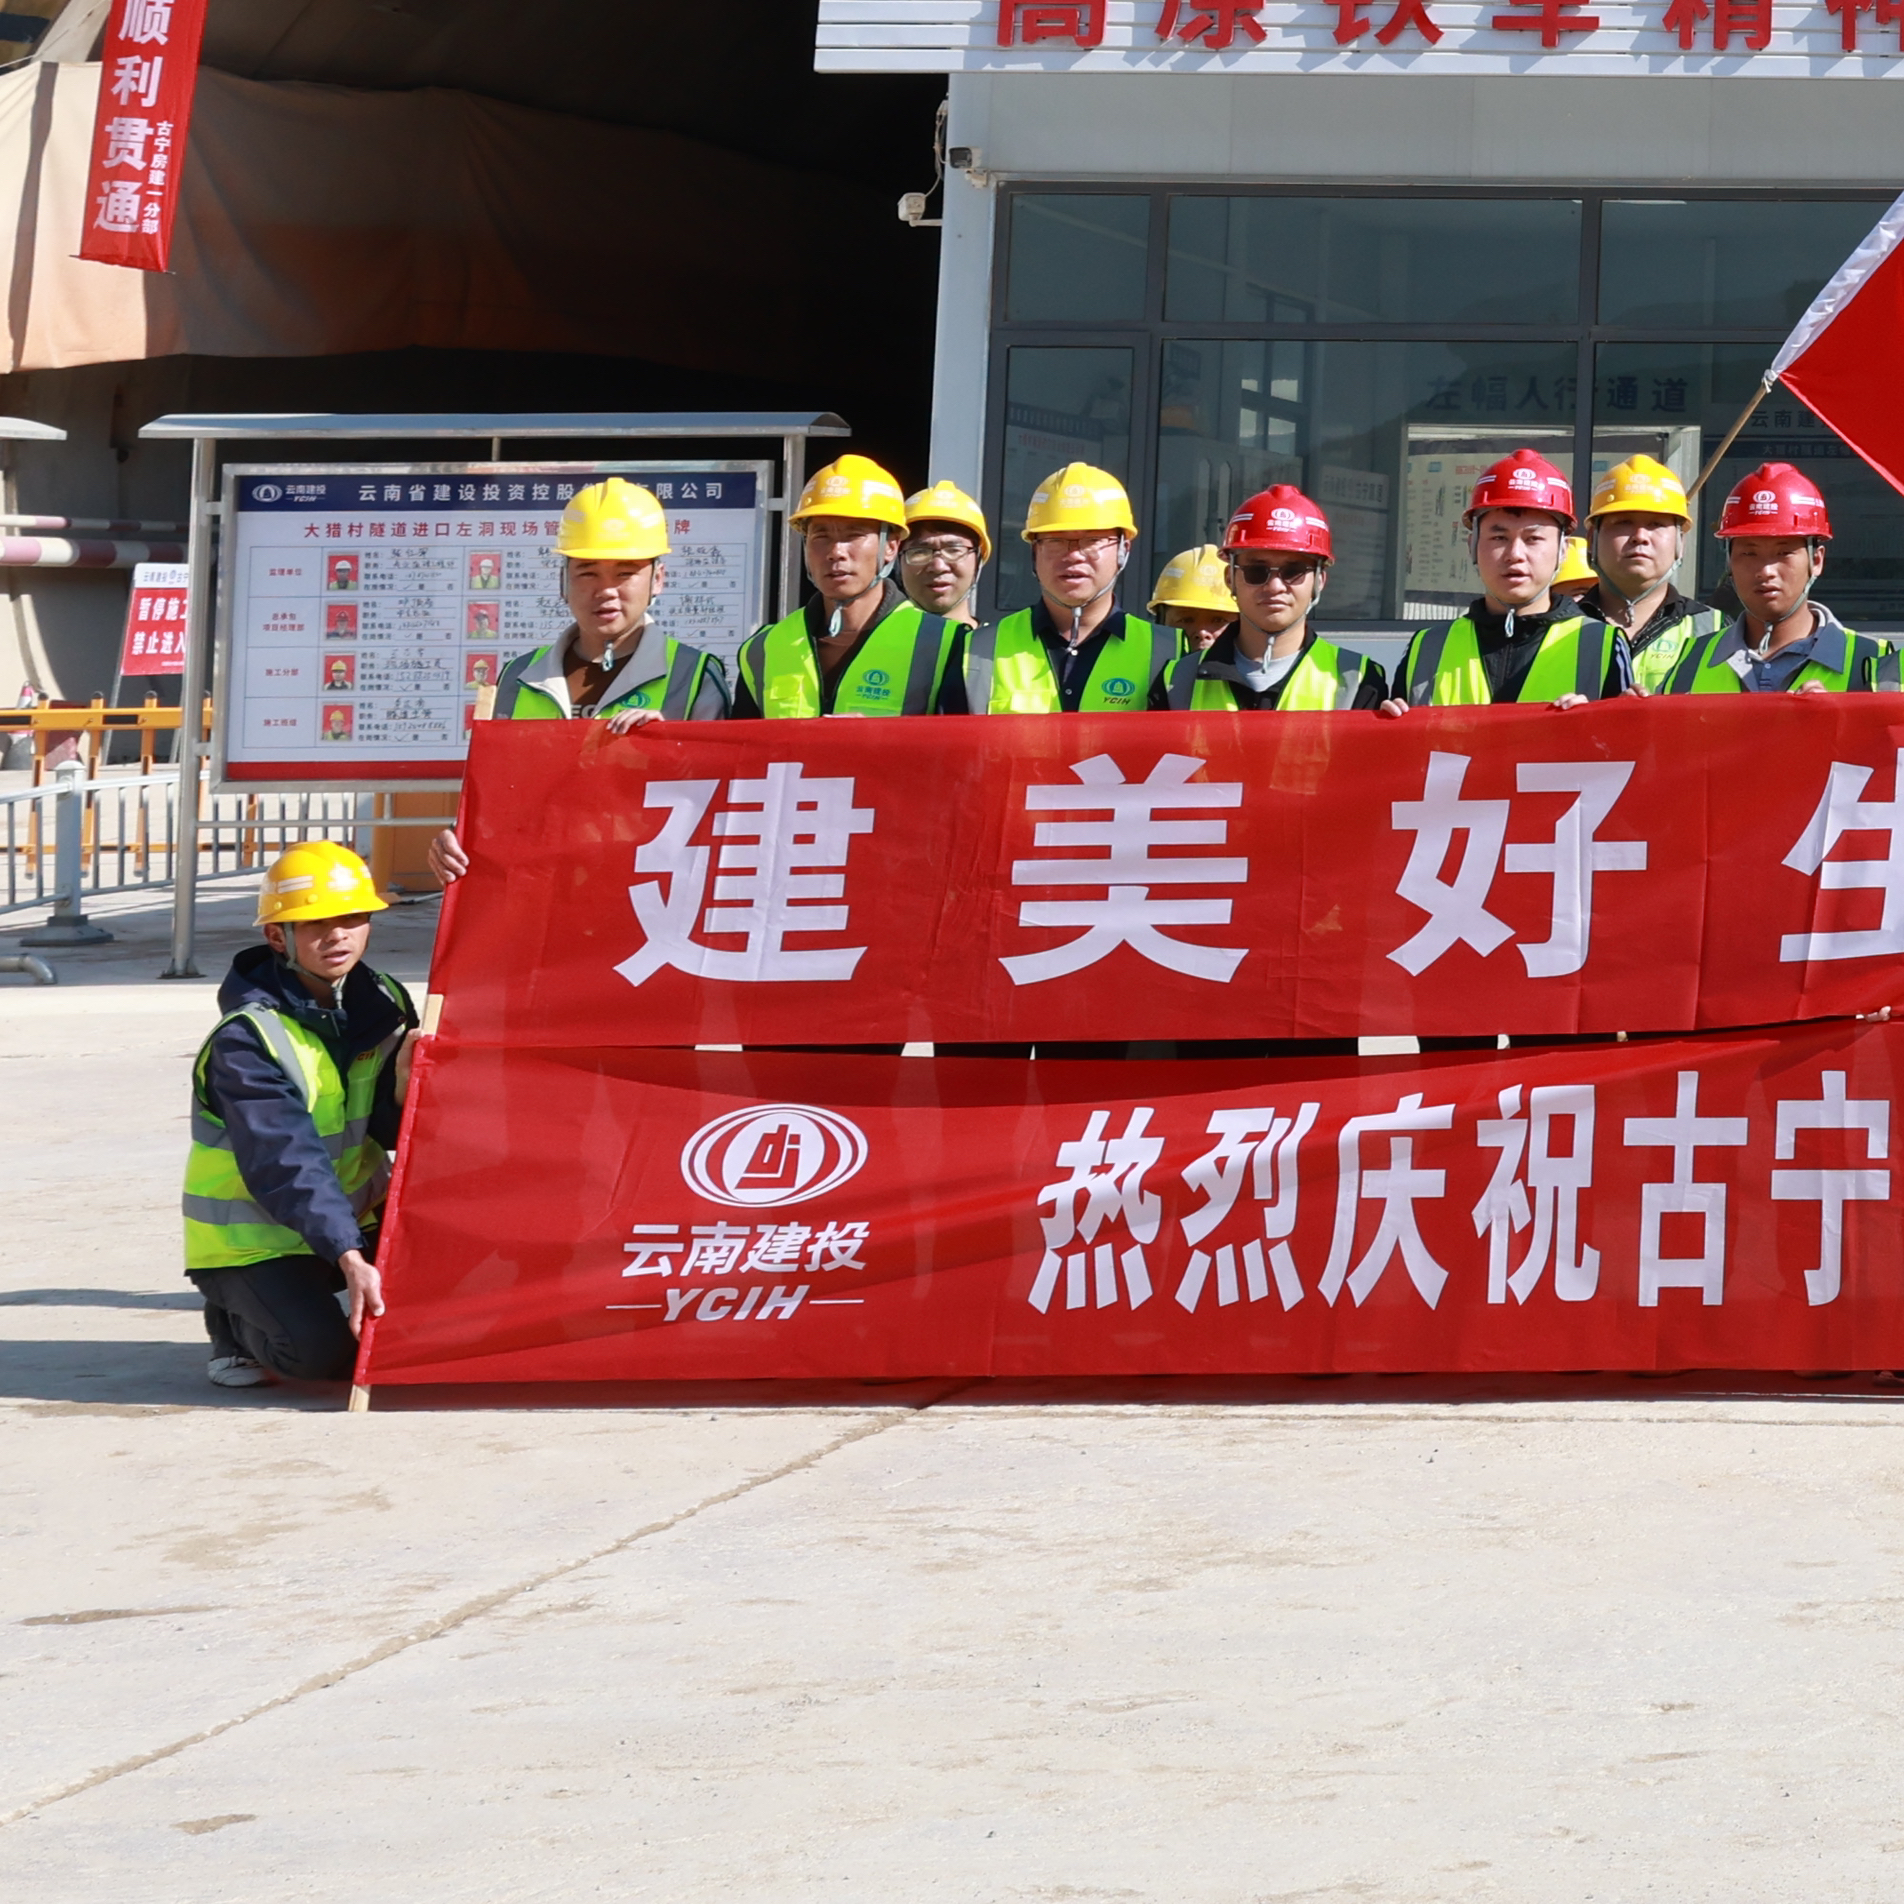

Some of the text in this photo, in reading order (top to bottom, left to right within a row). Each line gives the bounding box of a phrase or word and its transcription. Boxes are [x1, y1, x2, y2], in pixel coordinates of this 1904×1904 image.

[141, 120, 174, 234] 古宁房建一分部
[1751, 409, 1828, 428] 云南建
[286, 484, 326, 495] 云南建投
[304, 519, 691, 538] 大猎村隧道进口左洞现场管牌
[856, 685, 891, 695] 云南建投
[1103, 697, 1130, 705] YCIH
[622, 1221, 870, 1277] 云南建投
[663, 1275, 810, 1322] YCIH
